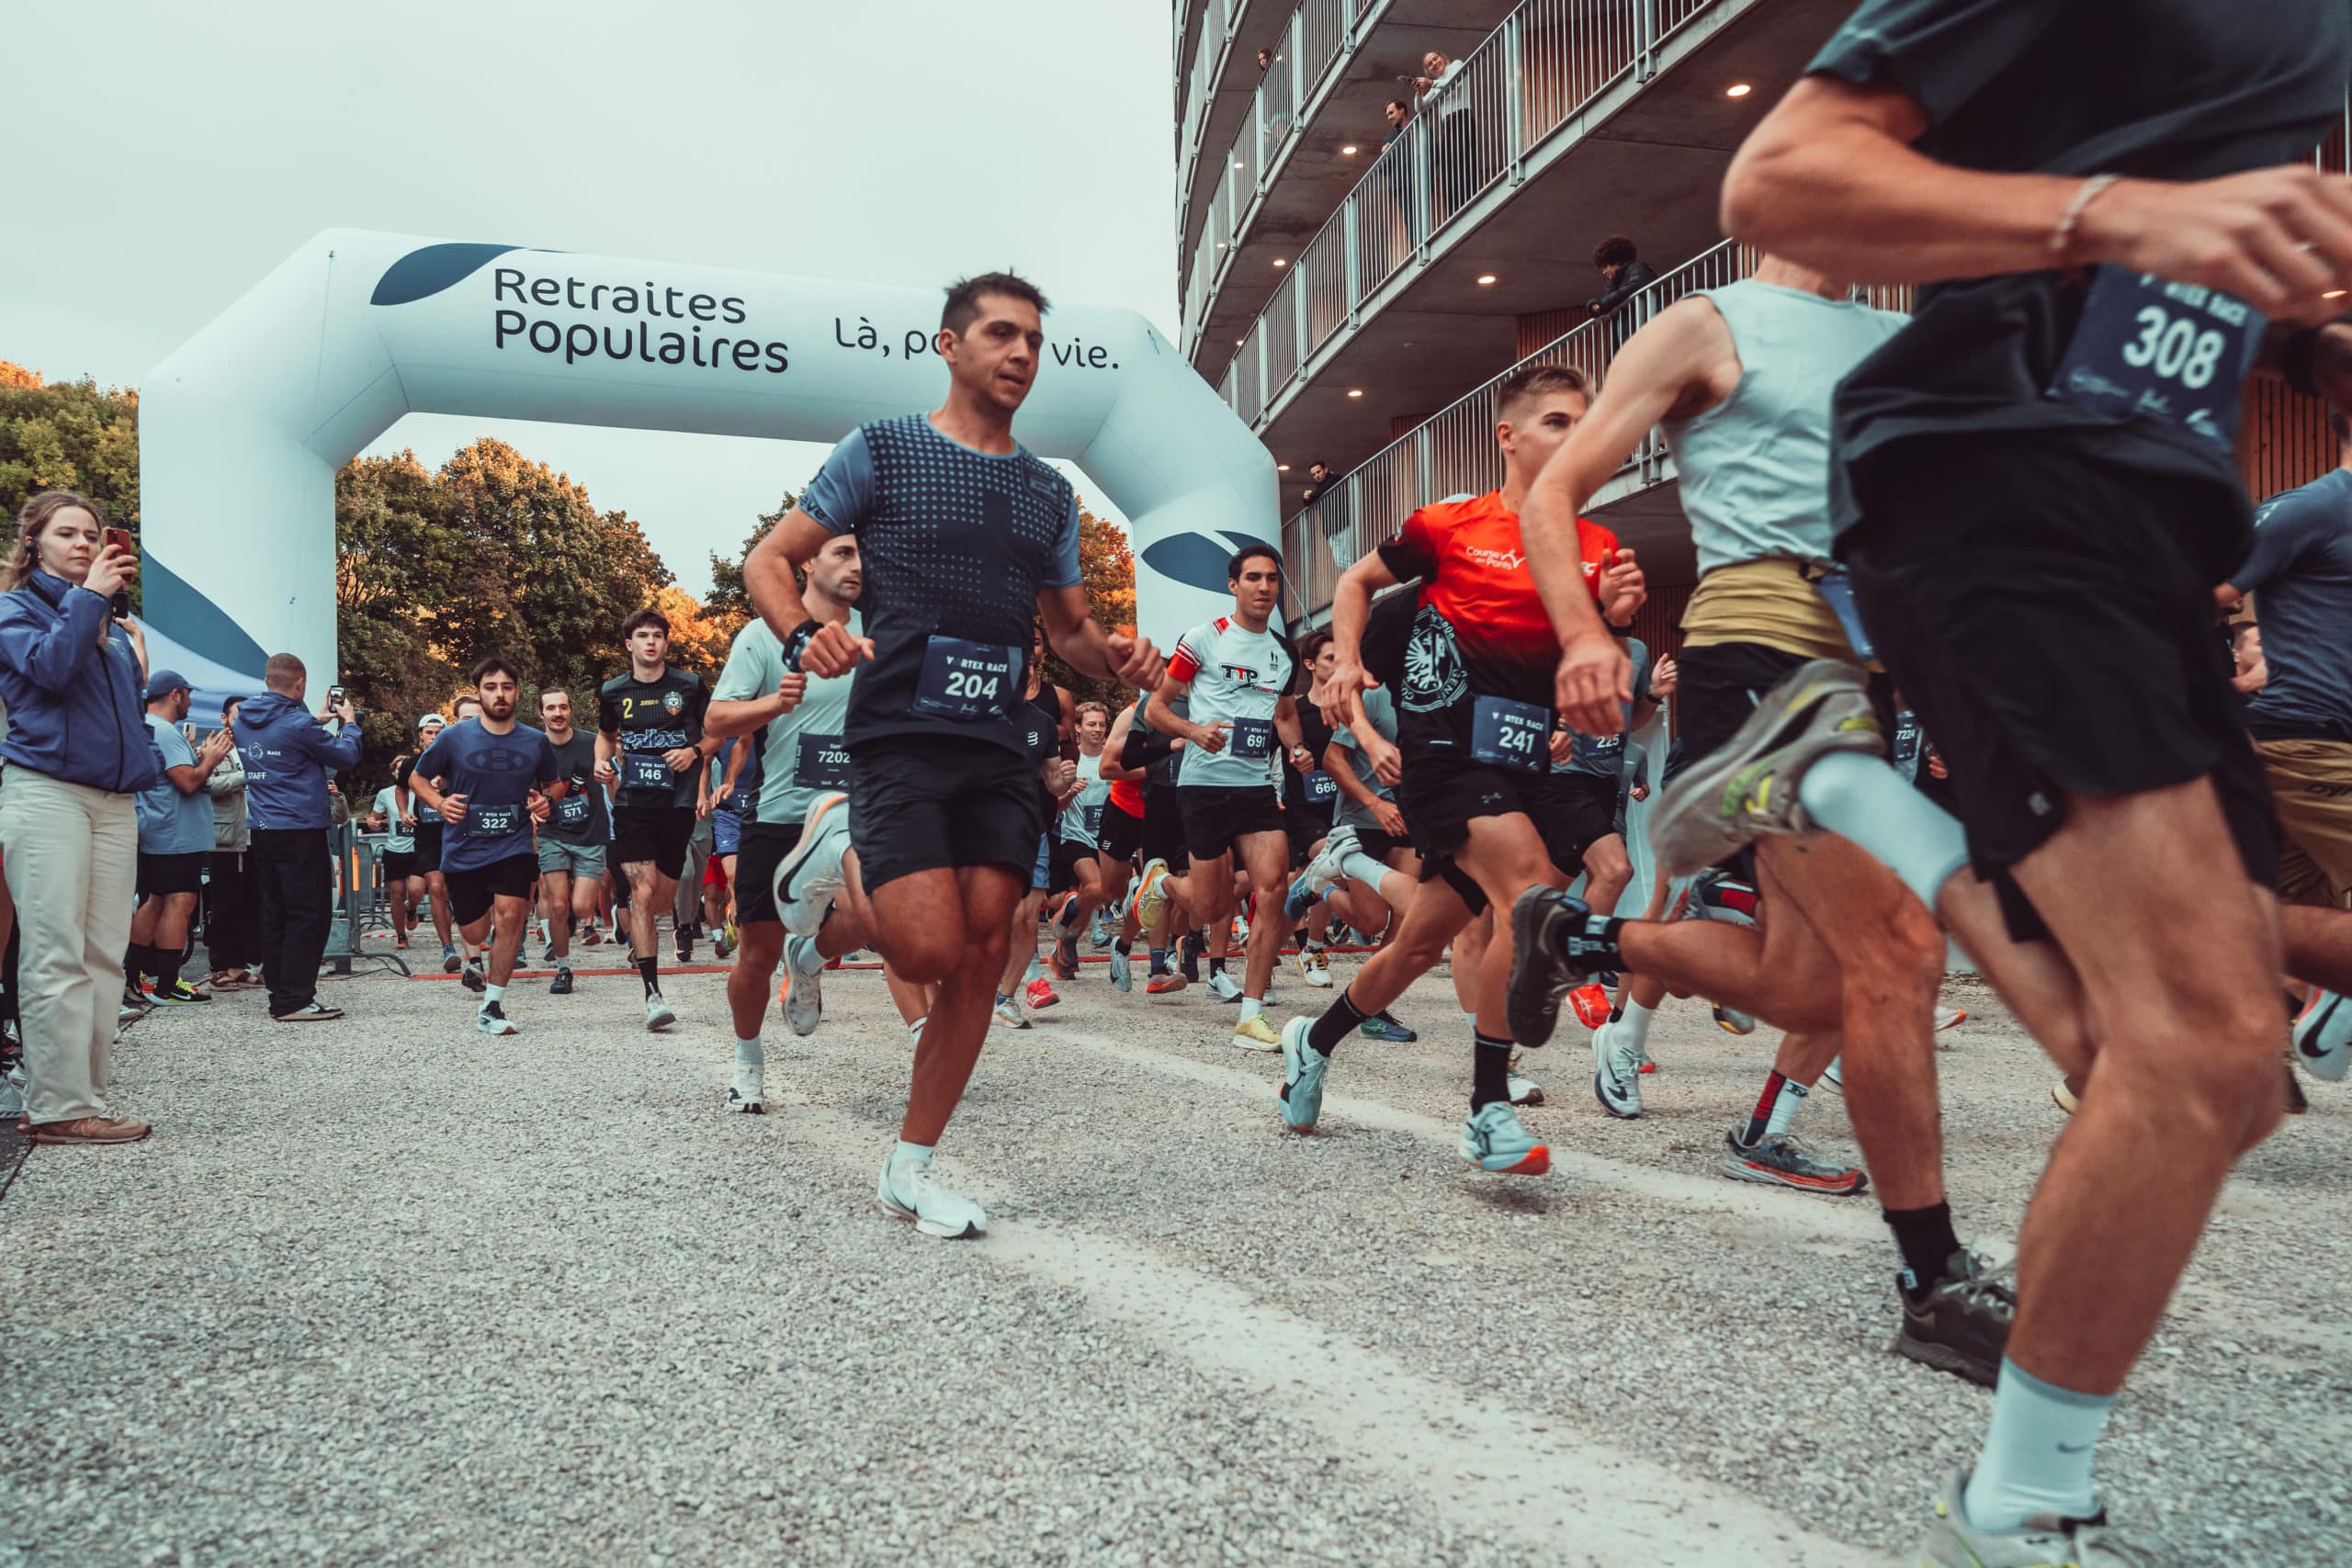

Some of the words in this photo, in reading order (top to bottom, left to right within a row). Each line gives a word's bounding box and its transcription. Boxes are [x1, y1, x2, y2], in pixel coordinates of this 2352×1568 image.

[494, 267, 746, 324] Retraites
[495, 309, 788, 374] Populaires
[834, 317, 890, 358] Là,
[1051, 336, 1120, 370] vie.
[2122, 305, 2225, 389] 308
[945, 654, 985, 671] VRTEX
[986, 661, 1009, 673] RACE
[1219, 663, 1260, 685] TTP
[944, 671, 999, 700] 204
[622, 697, 635, 719] 2
[1247, 734, 1266, 748] 691
[1498, 726, 1535, 753] 241
[818, 750, 851, 764] 7202
[639, 768, 662, 781] 146
[1315, 781, 1338, 795] 666
[481, 818, 508, 829] 322
[564, 807, 582, 818] 571
